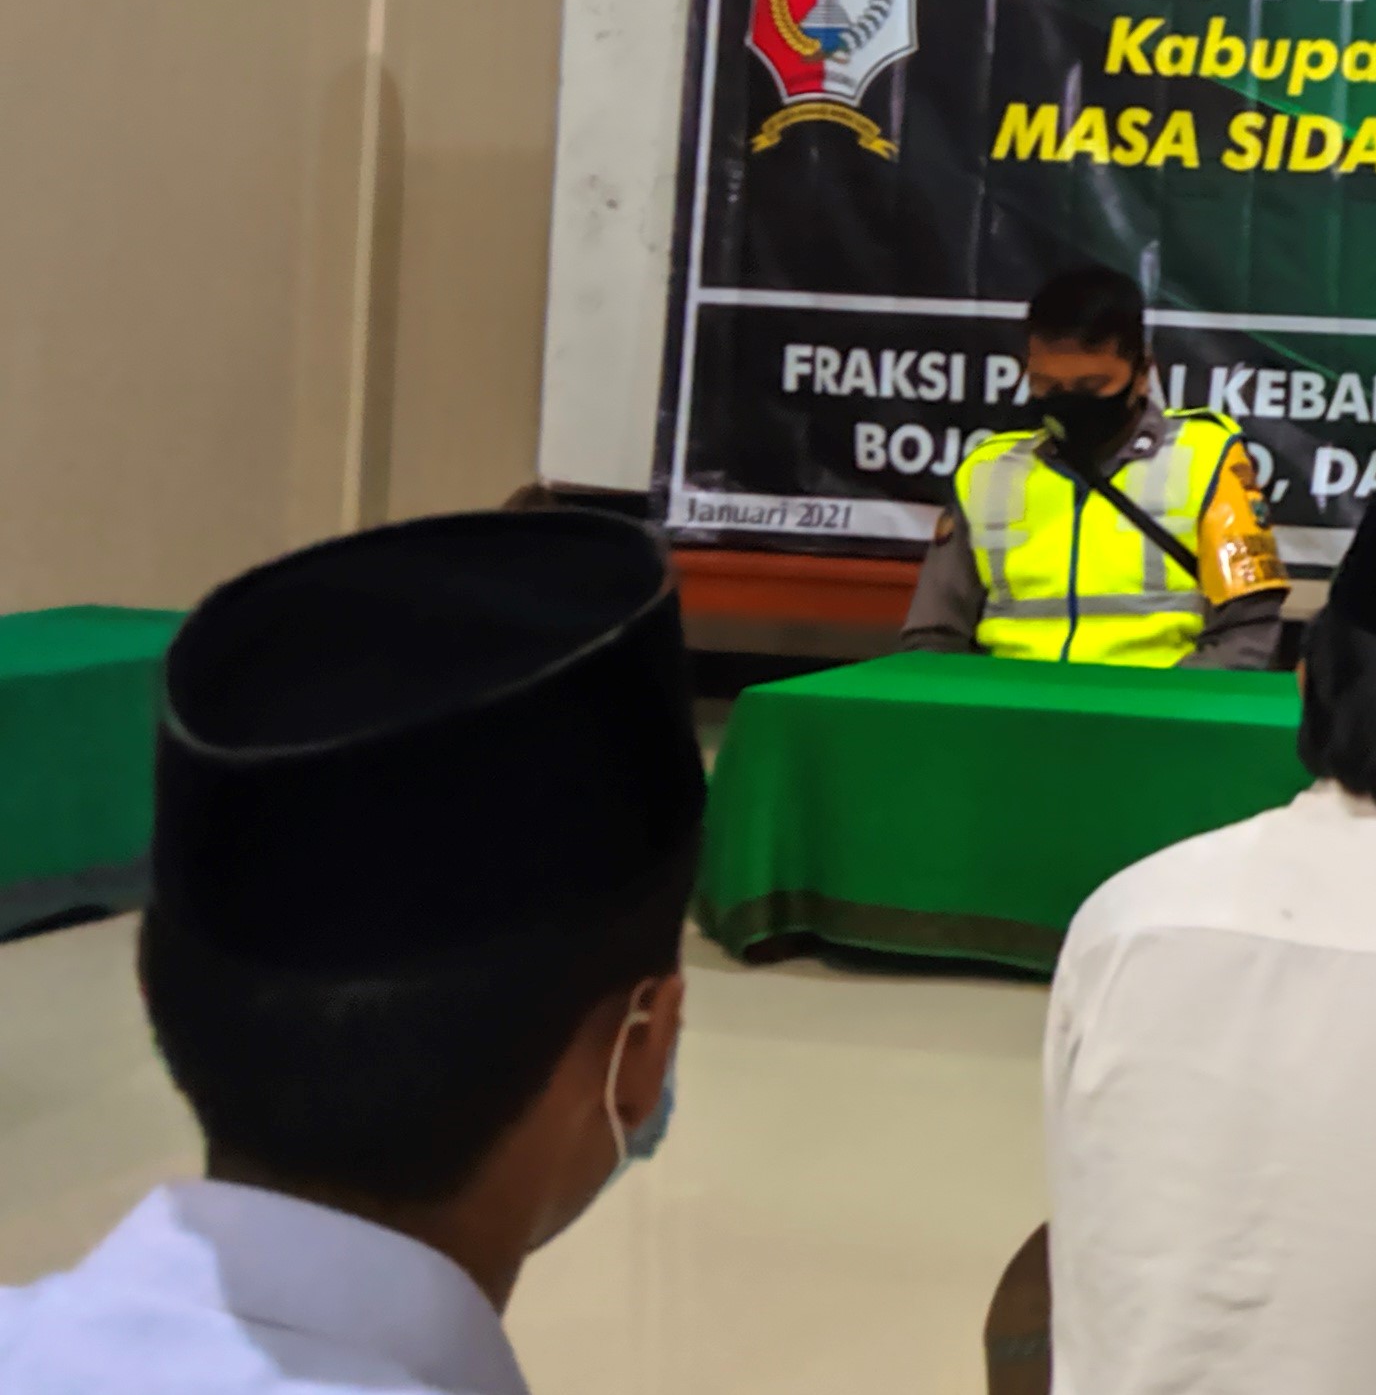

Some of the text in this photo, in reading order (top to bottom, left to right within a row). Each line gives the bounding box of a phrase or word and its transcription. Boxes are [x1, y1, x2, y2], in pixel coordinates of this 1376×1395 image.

[991, 103, 1200, 169] MASA
[782, 345, 965, 402] FRAKSI
[687, 497, 853, 530] Januari 2021
